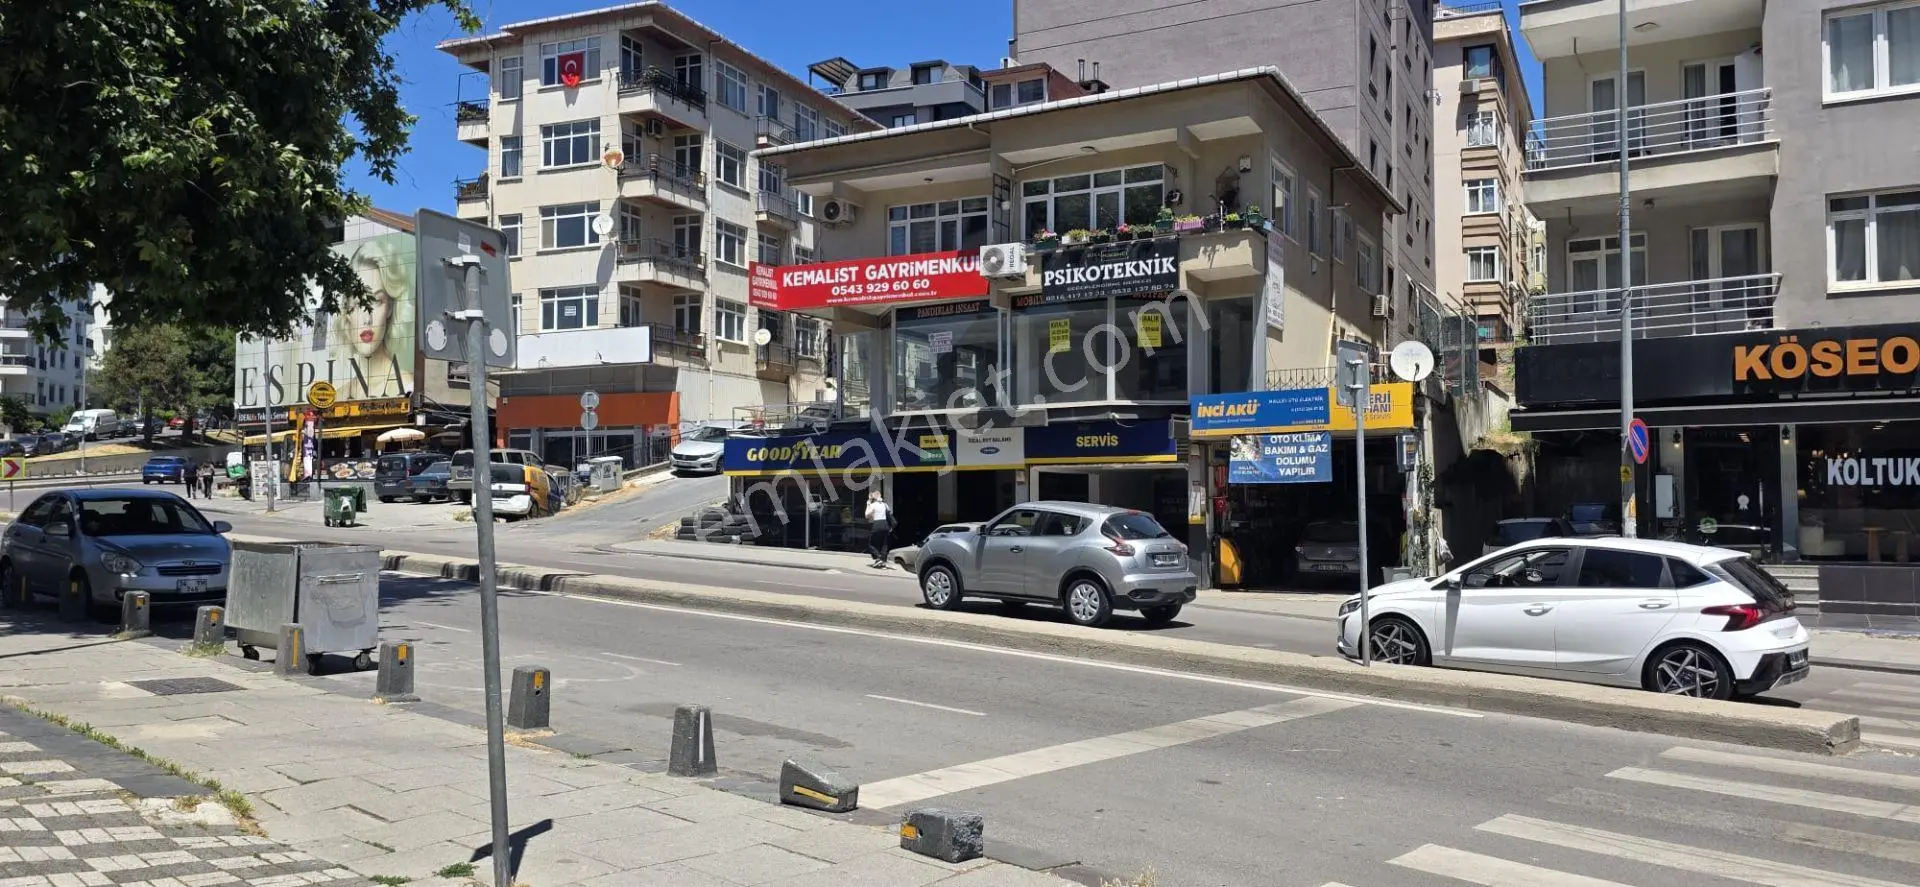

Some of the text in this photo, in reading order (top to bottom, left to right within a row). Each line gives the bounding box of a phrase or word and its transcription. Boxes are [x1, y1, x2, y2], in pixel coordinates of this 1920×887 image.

[1044, 253, 1177, 287] PSİKOTEKNİK
[831, 279, 930, 296] 0543 929 60 60
[1734, 335, 1920, 381] KÖSEO
[240, 353, 408, 407] ESPINA
[1226, 399, 1258, 416] AKÜ
[1075, 433, 1119, 448] SERVİS
[1270, 434, 1290, 444] OTO
[1264, 443, 1329, 455] BAKIMI & GAZ
[1276, 456, 1316, 466] DOLUMU
[1279, 467, 1316, 476] YAPILIR
[1827, 457, 1920, 487] KOLTUK
